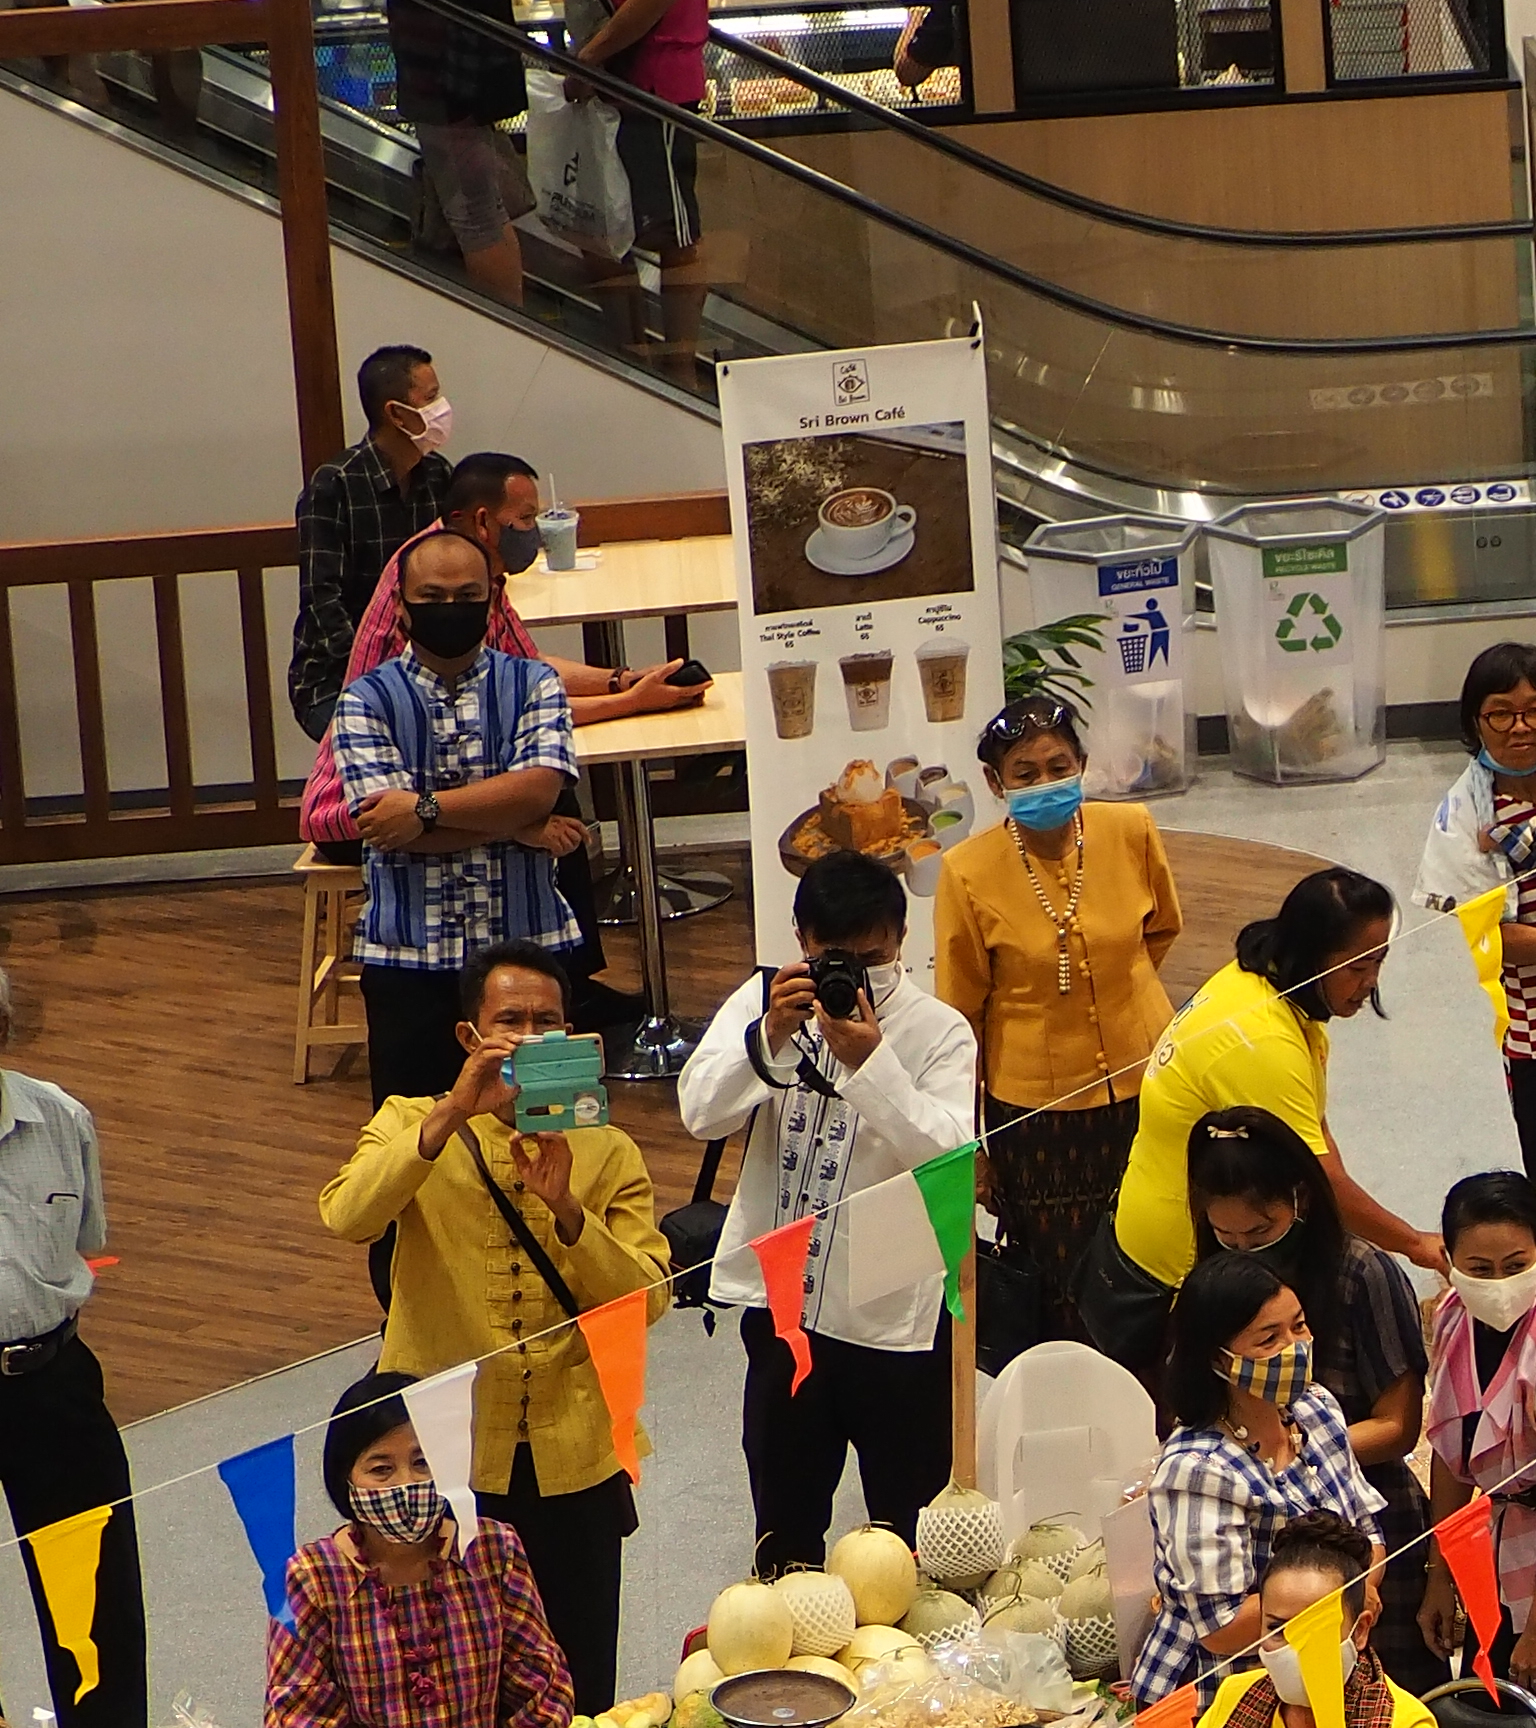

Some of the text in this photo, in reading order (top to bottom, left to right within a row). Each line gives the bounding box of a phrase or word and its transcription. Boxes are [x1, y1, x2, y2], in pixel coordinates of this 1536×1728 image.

[799, 406, 905, 429] Sri Brown Café
[1111, 577, 1170, 592] GENERAL WASTE
[917, 613, 961, 625] Cappuccino
[855, 623, 873, 632] Latte
[759, 628, 821, 643] Thai Style Coffee
